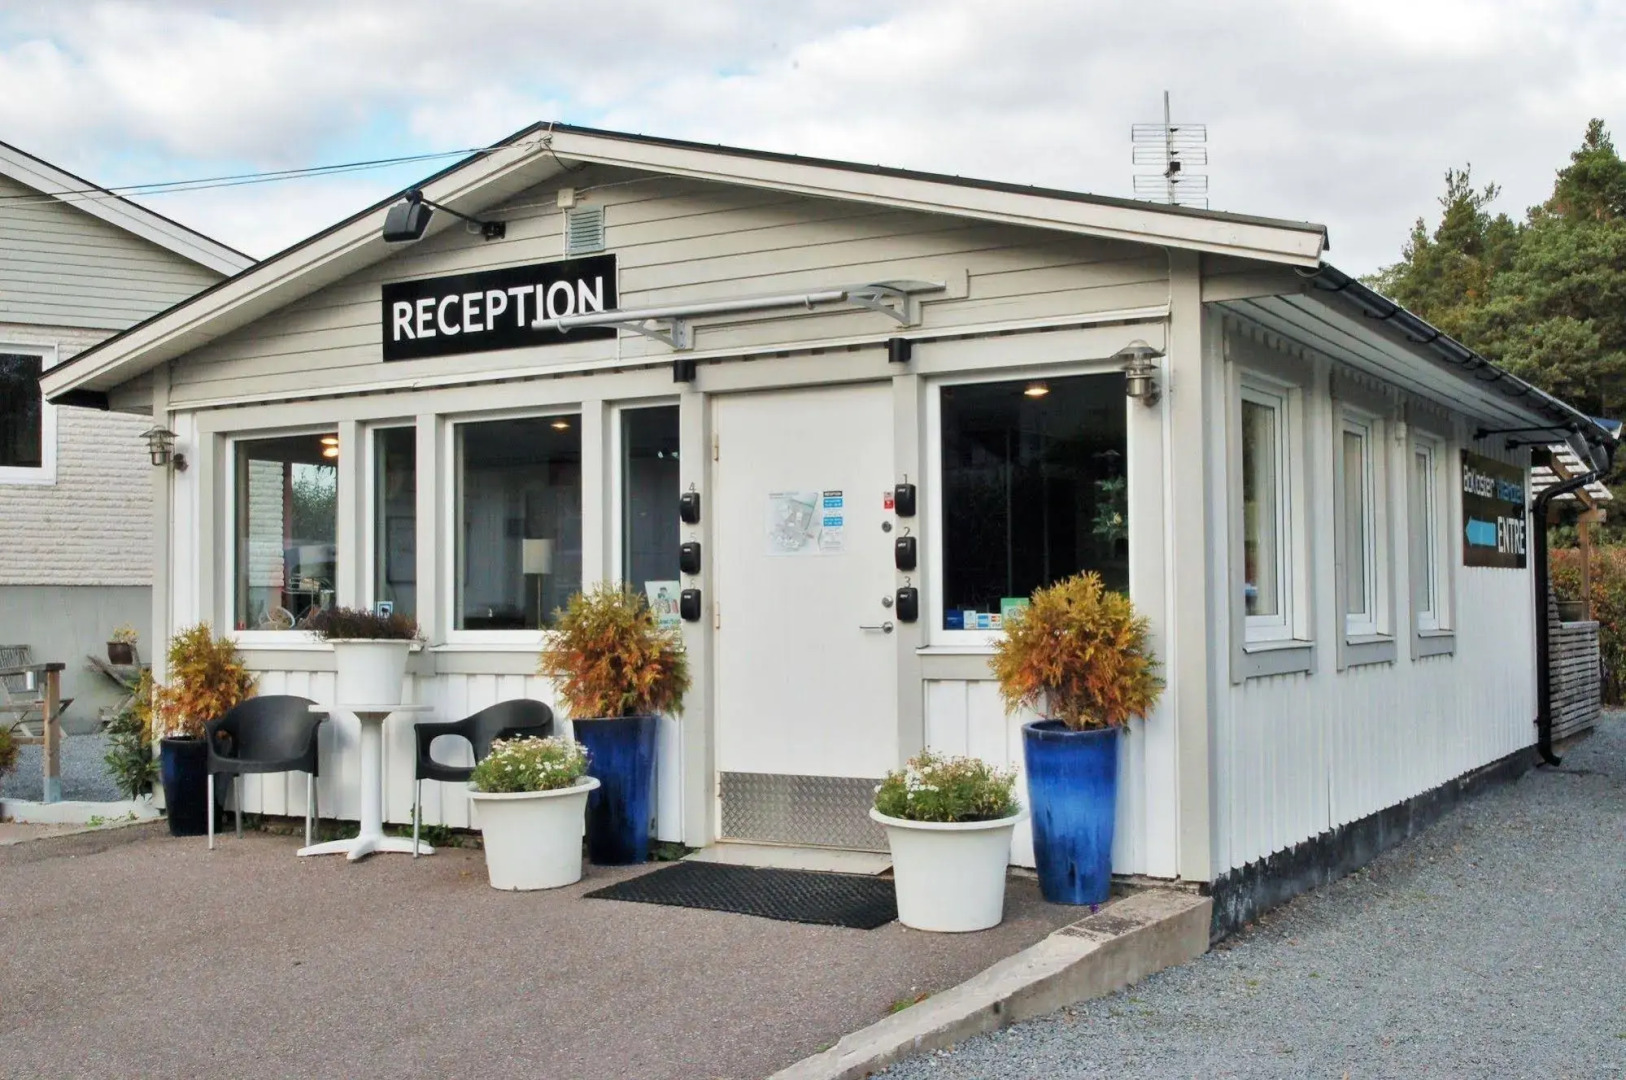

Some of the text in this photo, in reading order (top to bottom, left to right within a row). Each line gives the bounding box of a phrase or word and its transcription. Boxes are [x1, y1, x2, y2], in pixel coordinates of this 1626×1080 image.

[392, 276, 604, 342] RECEPTION
[689, 481, 696, 493] 4
[903, 526, 911, 537] 2
[1497, 510, 1526, 555] ENTRÉ
[904, 576, 911, 588] 3
